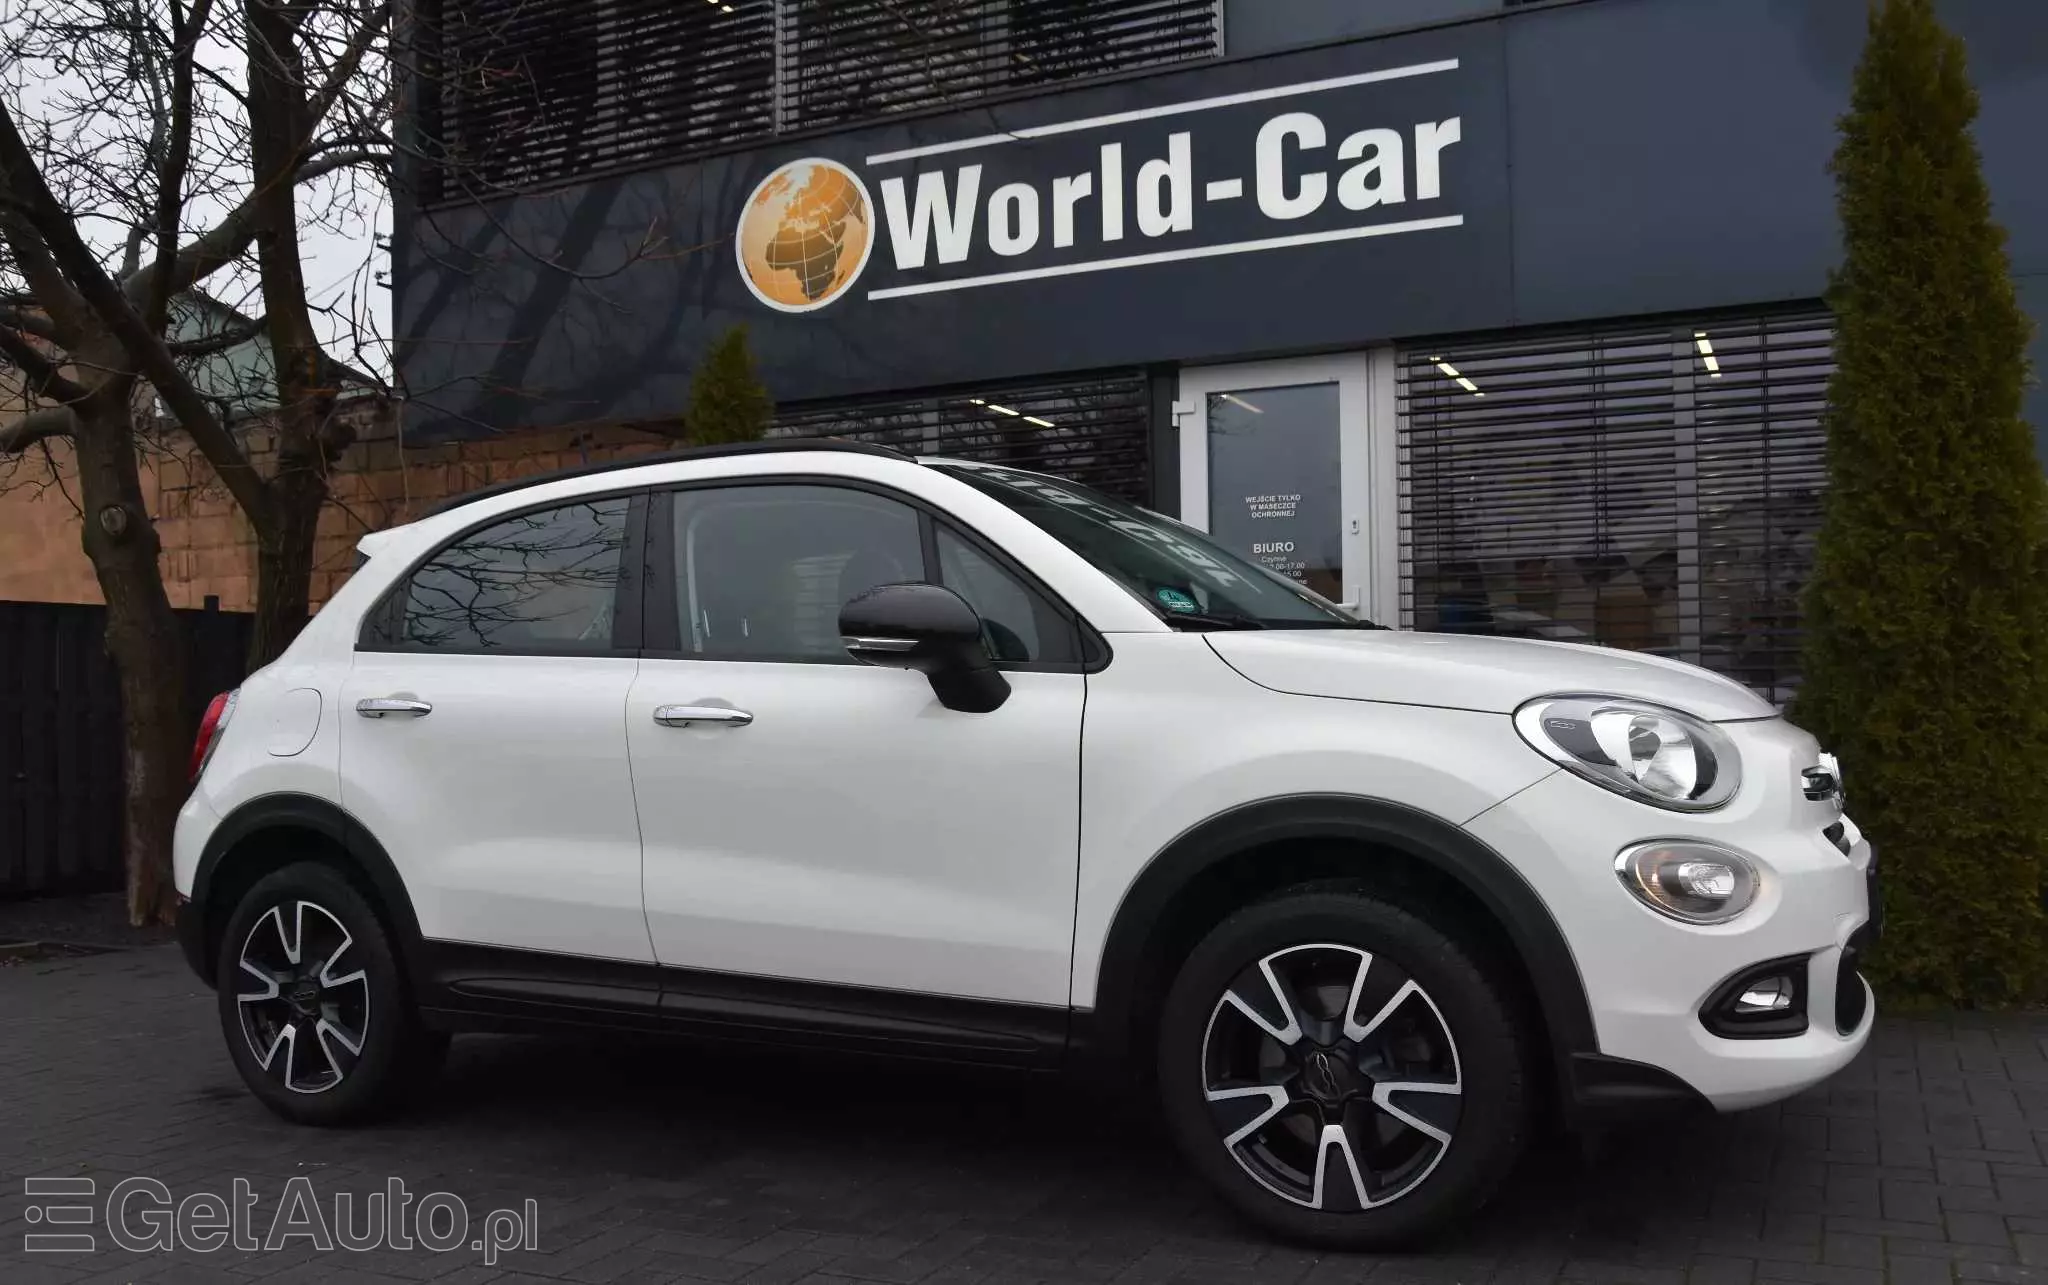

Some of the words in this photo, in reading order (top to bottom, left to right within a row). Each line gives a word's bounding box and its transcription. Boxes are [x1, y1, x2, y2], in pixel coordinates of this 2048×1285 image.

[880, 111, 1462, 271] World-Car
[1278, 494, 1301, 502] TYLKO
[1251, 510, 1296, 519] OCHRONNEJ
[1253, 541, 1295, 554] BIURO
